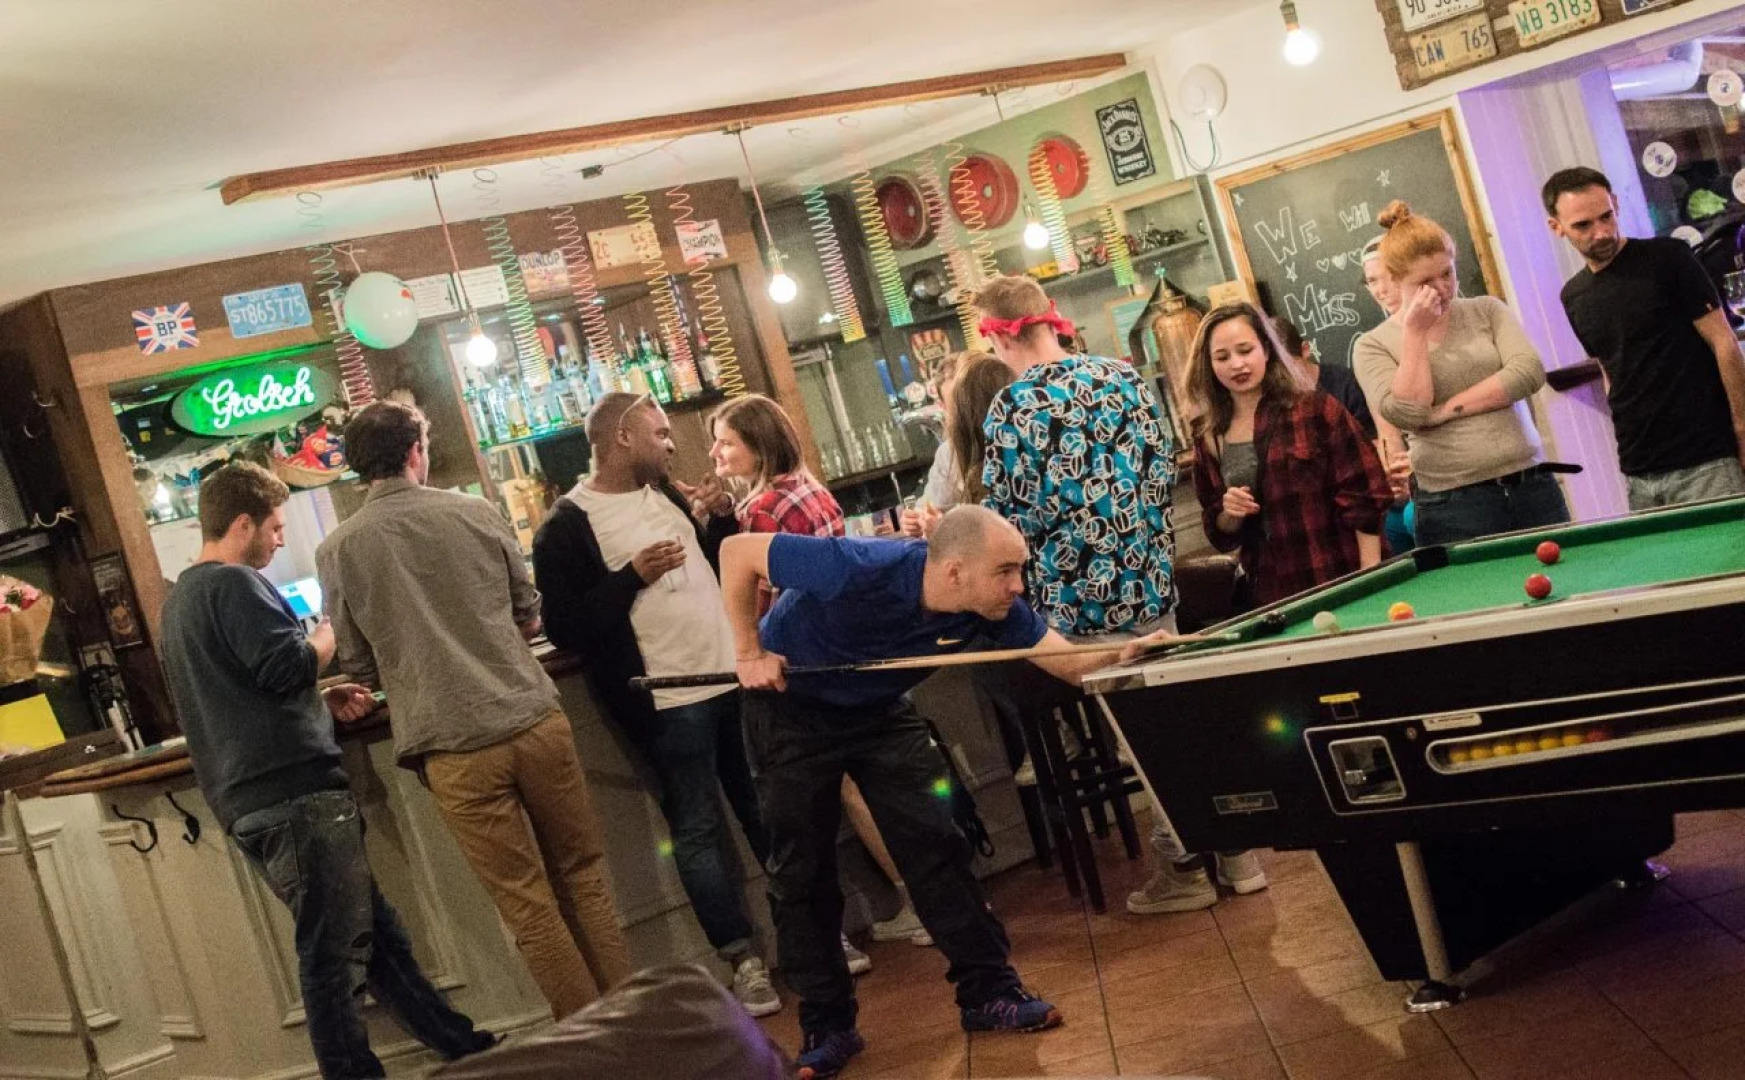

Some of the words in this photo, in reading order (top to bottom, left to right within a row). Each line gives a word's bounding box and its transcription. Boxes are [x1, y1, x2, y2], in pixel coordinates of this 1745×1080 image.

[1516, 7, 1543, 34] WB
[1461, 24, 1490, 52] 765
[1254, 206, 1321, 263] WE
[520, 251, 560, 270] DUNLOP
[155, 321, 177, 337] BP
[202, 367, 315, 429] Grolsch
